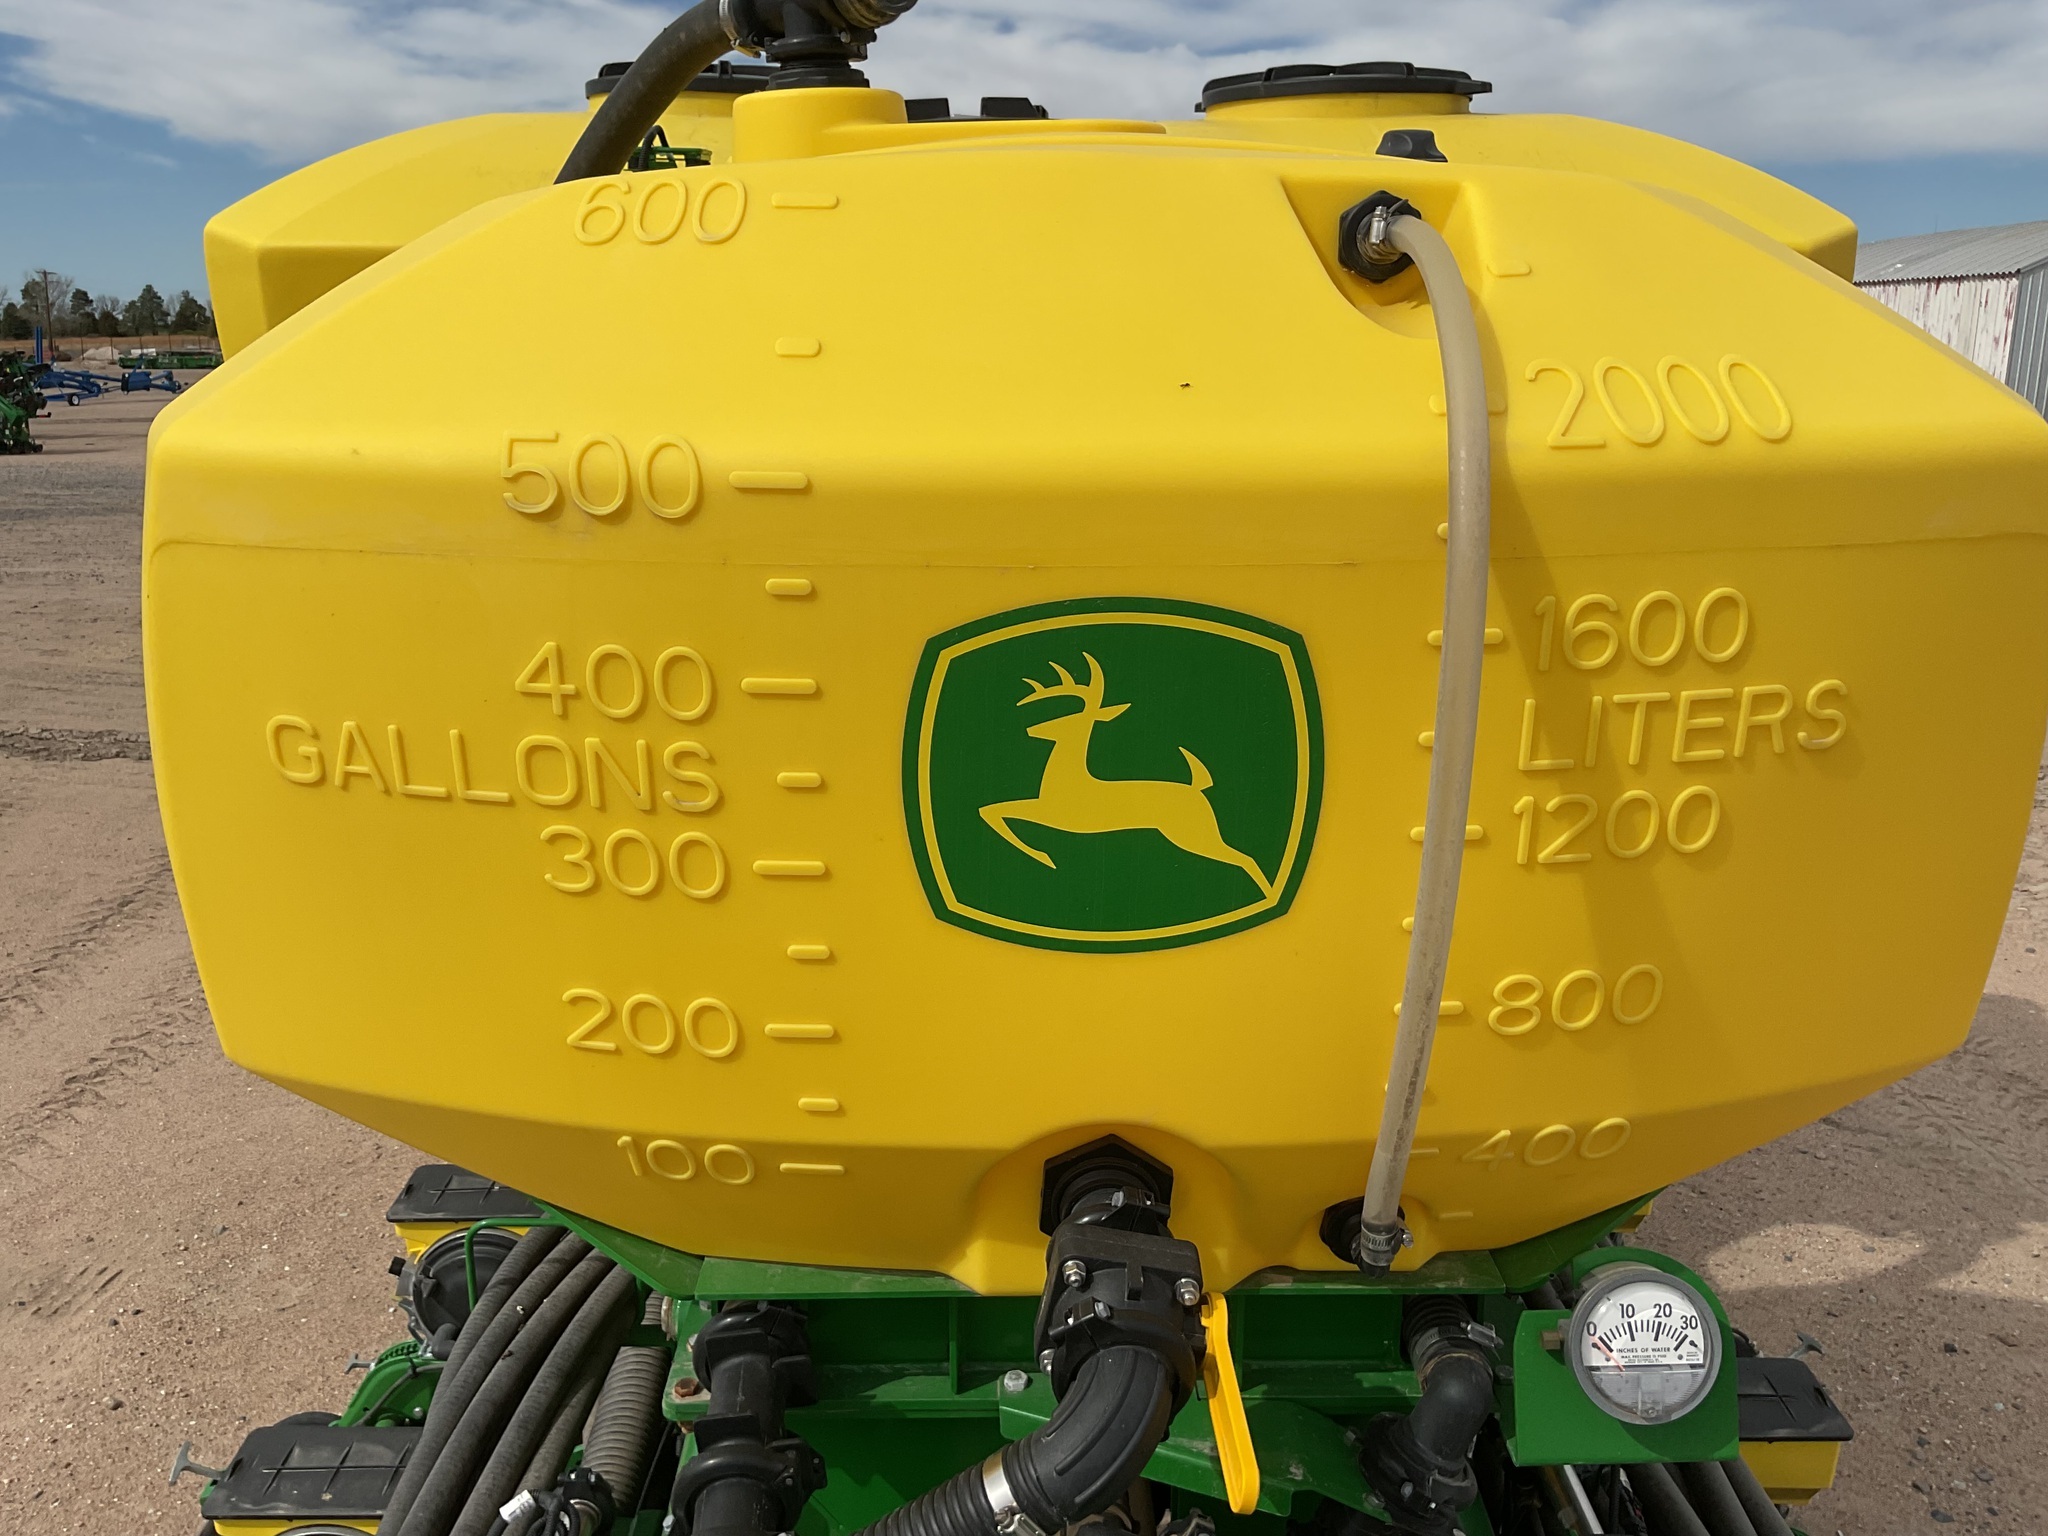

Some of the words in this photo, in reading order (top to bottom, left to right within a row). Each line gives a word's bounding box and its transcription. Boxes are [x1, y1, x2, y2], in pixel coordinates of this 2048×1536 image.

[574, 175, 748, 246] 600
[1525, 354, 1793, 450] 2000
[501, 429, 702, 519] 500
[1535, 587, 1749, 671] 1600
[514, 641, 713, 721] 400
[265, 714, 720, 813] GALLONS
[1518, 679, 1848, 771] LITERS
[540, 824, 726, 899] 300
[1513, 785, 1721, 865] 1200
[562, 987, 739, 1058] 200
[1488, 964, 1664, 1036] 800
[617, 1135, 755, 1185] 100
[1461, 1117, 1632, 1171] 400
[1586, 1321, 1597, 1337] 0
[1619, 1303, 1635, 1319] 10
[1653, 1303, 1672, 1318] 20
[1680, 1315, 1698, 1330] 30
